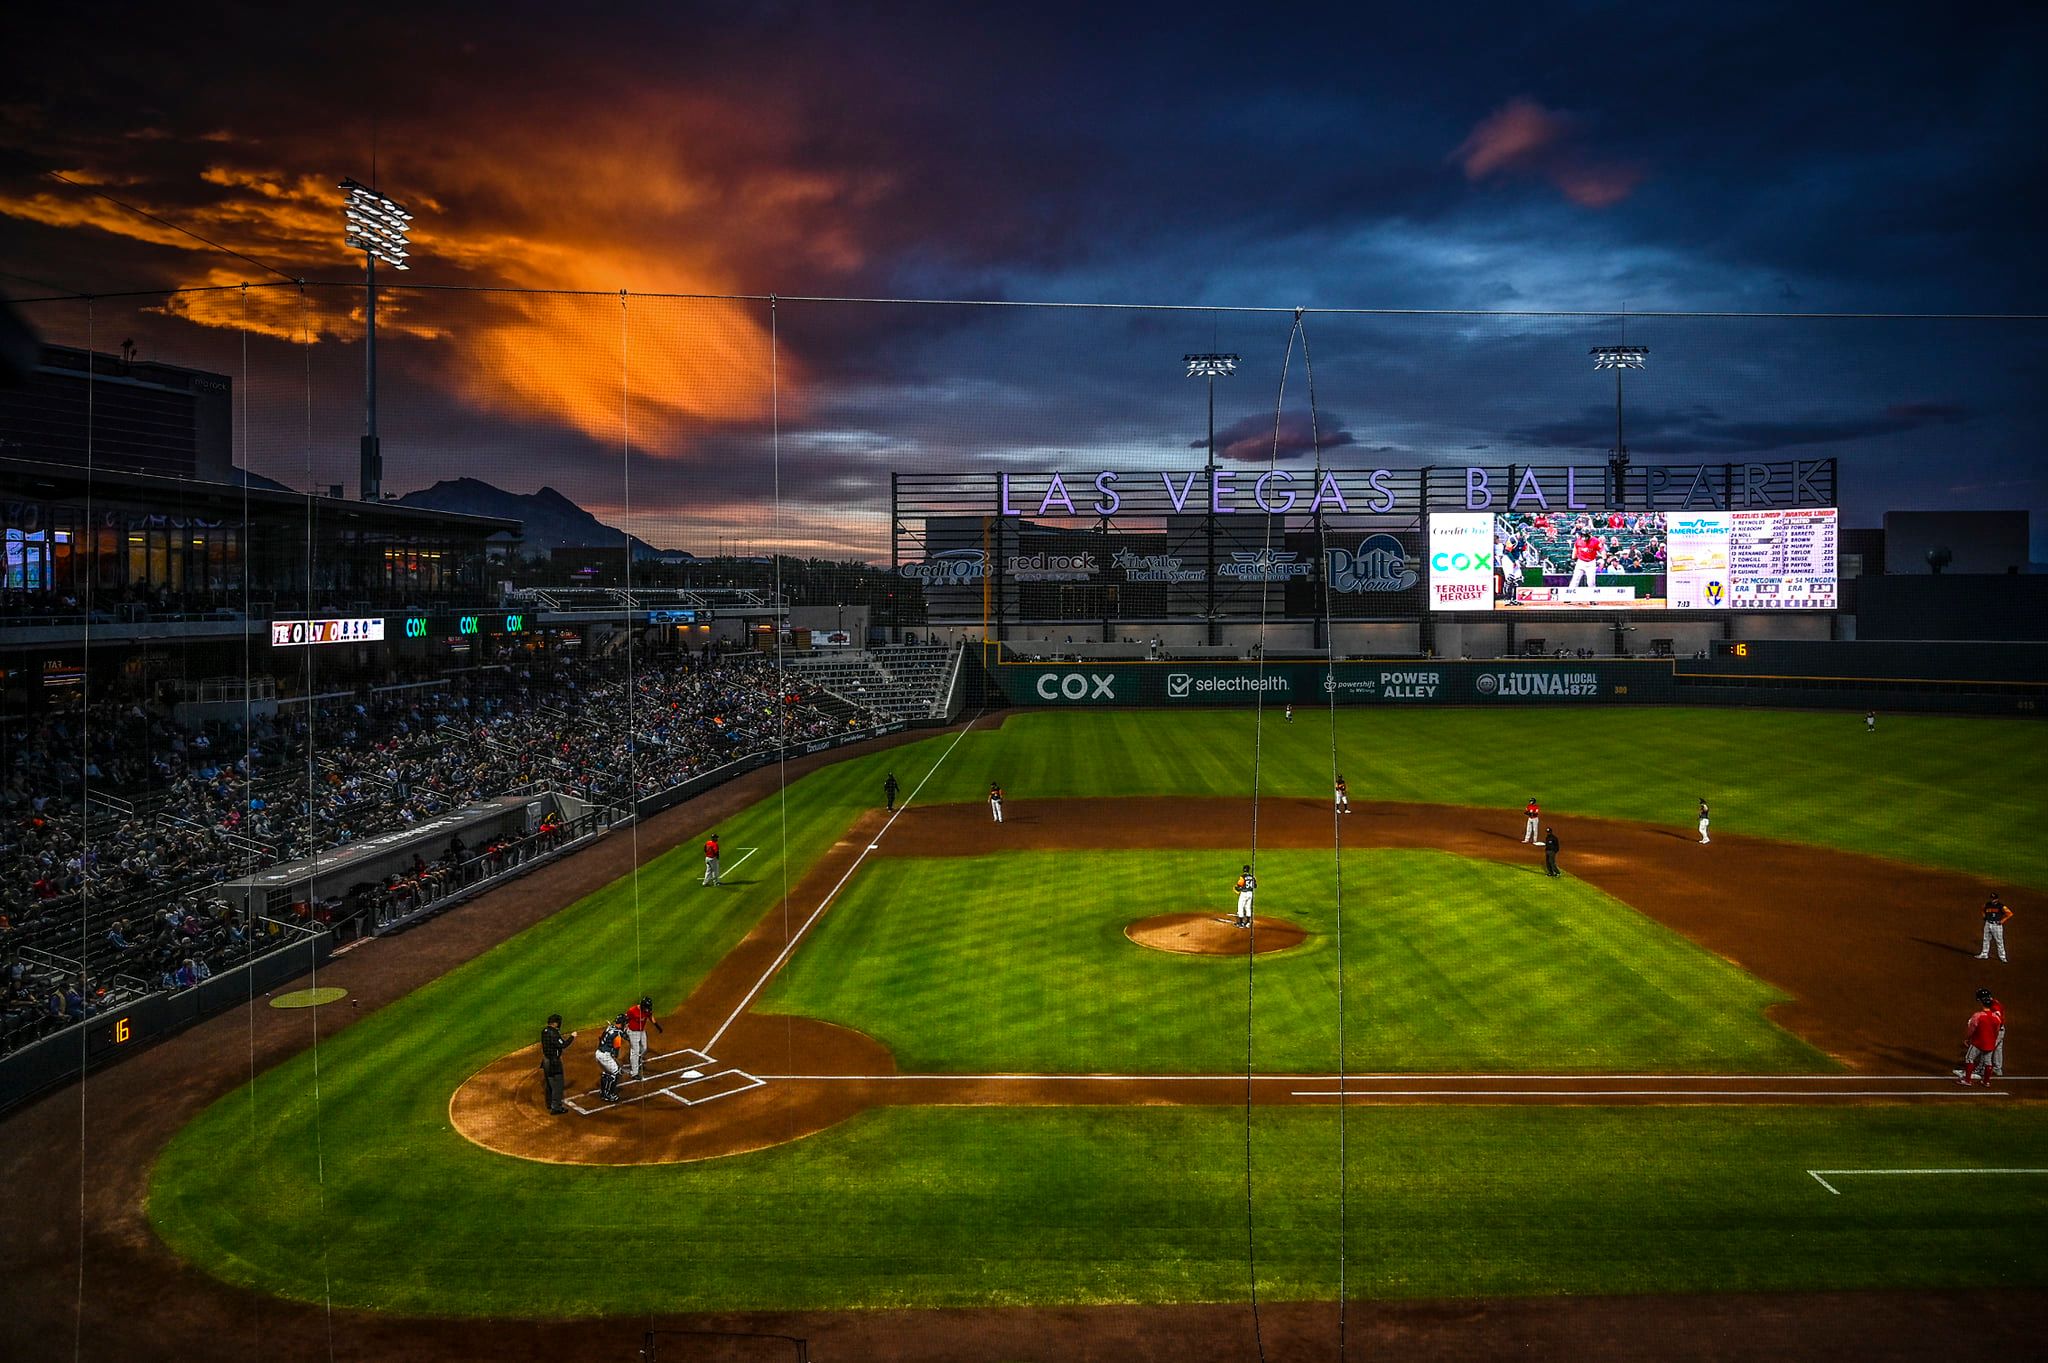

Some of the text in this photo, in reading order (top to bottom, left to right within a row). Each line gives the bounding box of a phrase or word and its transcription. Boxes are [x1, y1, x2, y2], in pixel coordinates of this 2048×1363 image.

[1002, 459, 1830, 516] LAS VEGAS BALLPARK
[900, 559, 993, 579] CreditOne
[1009, 551, 1096, 570] red rock
[1145, 553, 1182, 571] Valley
[1326, 547, 1405, 588] Pulte
[1432, 552, 1492, 572] COX
[1126, 568, 1205, 584] Health System
[1218, 563, 1312, 576] AMERICA FIRST
[1346, 575, 1403, 595] Homes
[1435, 584, 1488, 593] TERRIBLE
[1439, 592, 1482, 602] HERBST
[343, 621, 348, 634] B
[353, 621, 358, 634] S
[362, 620, 368, 633] O
[406, 618, 427, 637] COX
[460, 616, 478, 635] COX
[507, 615, 523, 632] COX
[1036, 672, 1115, 700] COX
[1338, 680, 1376, 689] powershift
[1380, 672, 1440, 685] POWER
[1497, 672, 1570, 696] LiUNA!
[1570, 673, 1598, 684] LOCAL
[1383, 685, 1437, 698] ALLEY
[1570, 684, 1597, 695] 872
